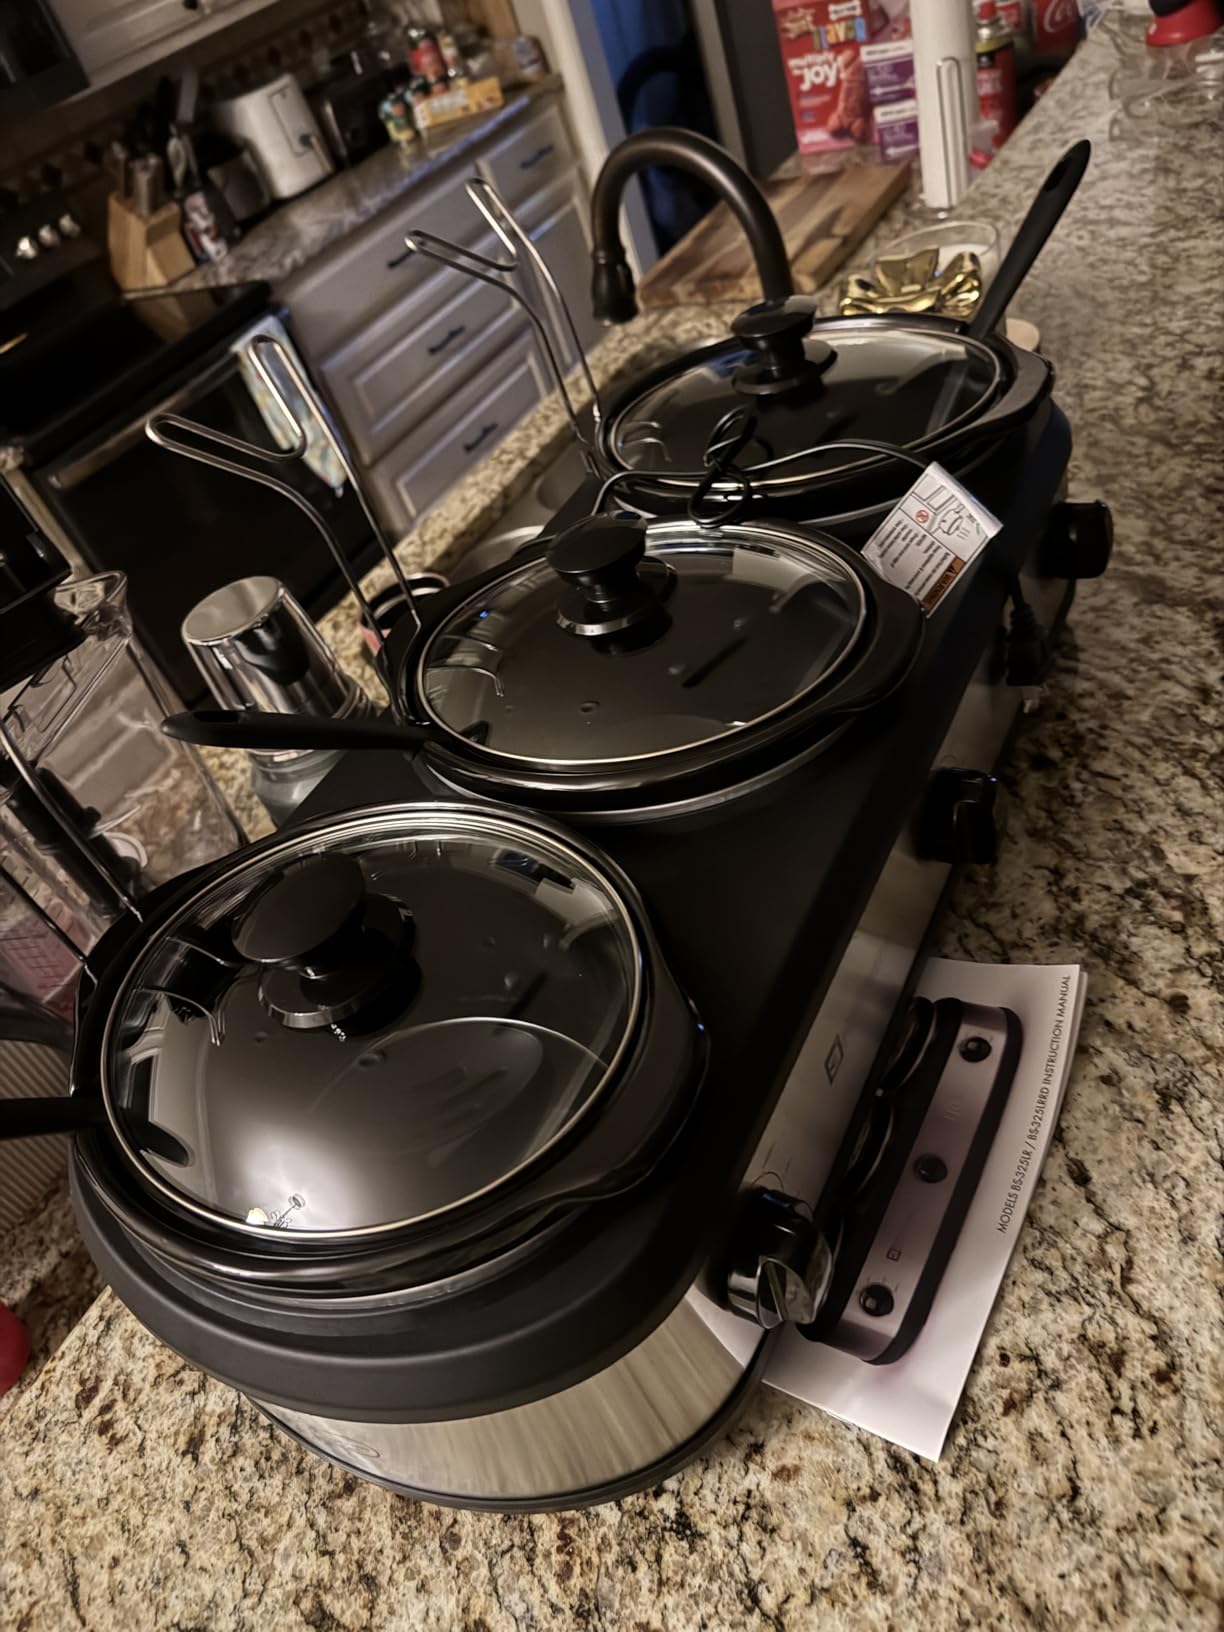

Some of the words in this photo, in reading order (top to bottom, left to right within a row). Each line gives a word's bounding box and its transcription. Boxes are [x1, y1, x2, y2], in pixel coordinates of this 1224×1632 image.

[996, 1192, 1019, 1234] MODELS
[1010, 1149, 1033, 1192] BS-325LR
[1027, 1087, 1050, 1141] BS-325LRRD
[1042, 1019, 1063, 1085] INSTRUCTION
[1056, 975, 1071, 1018] MANUAL
